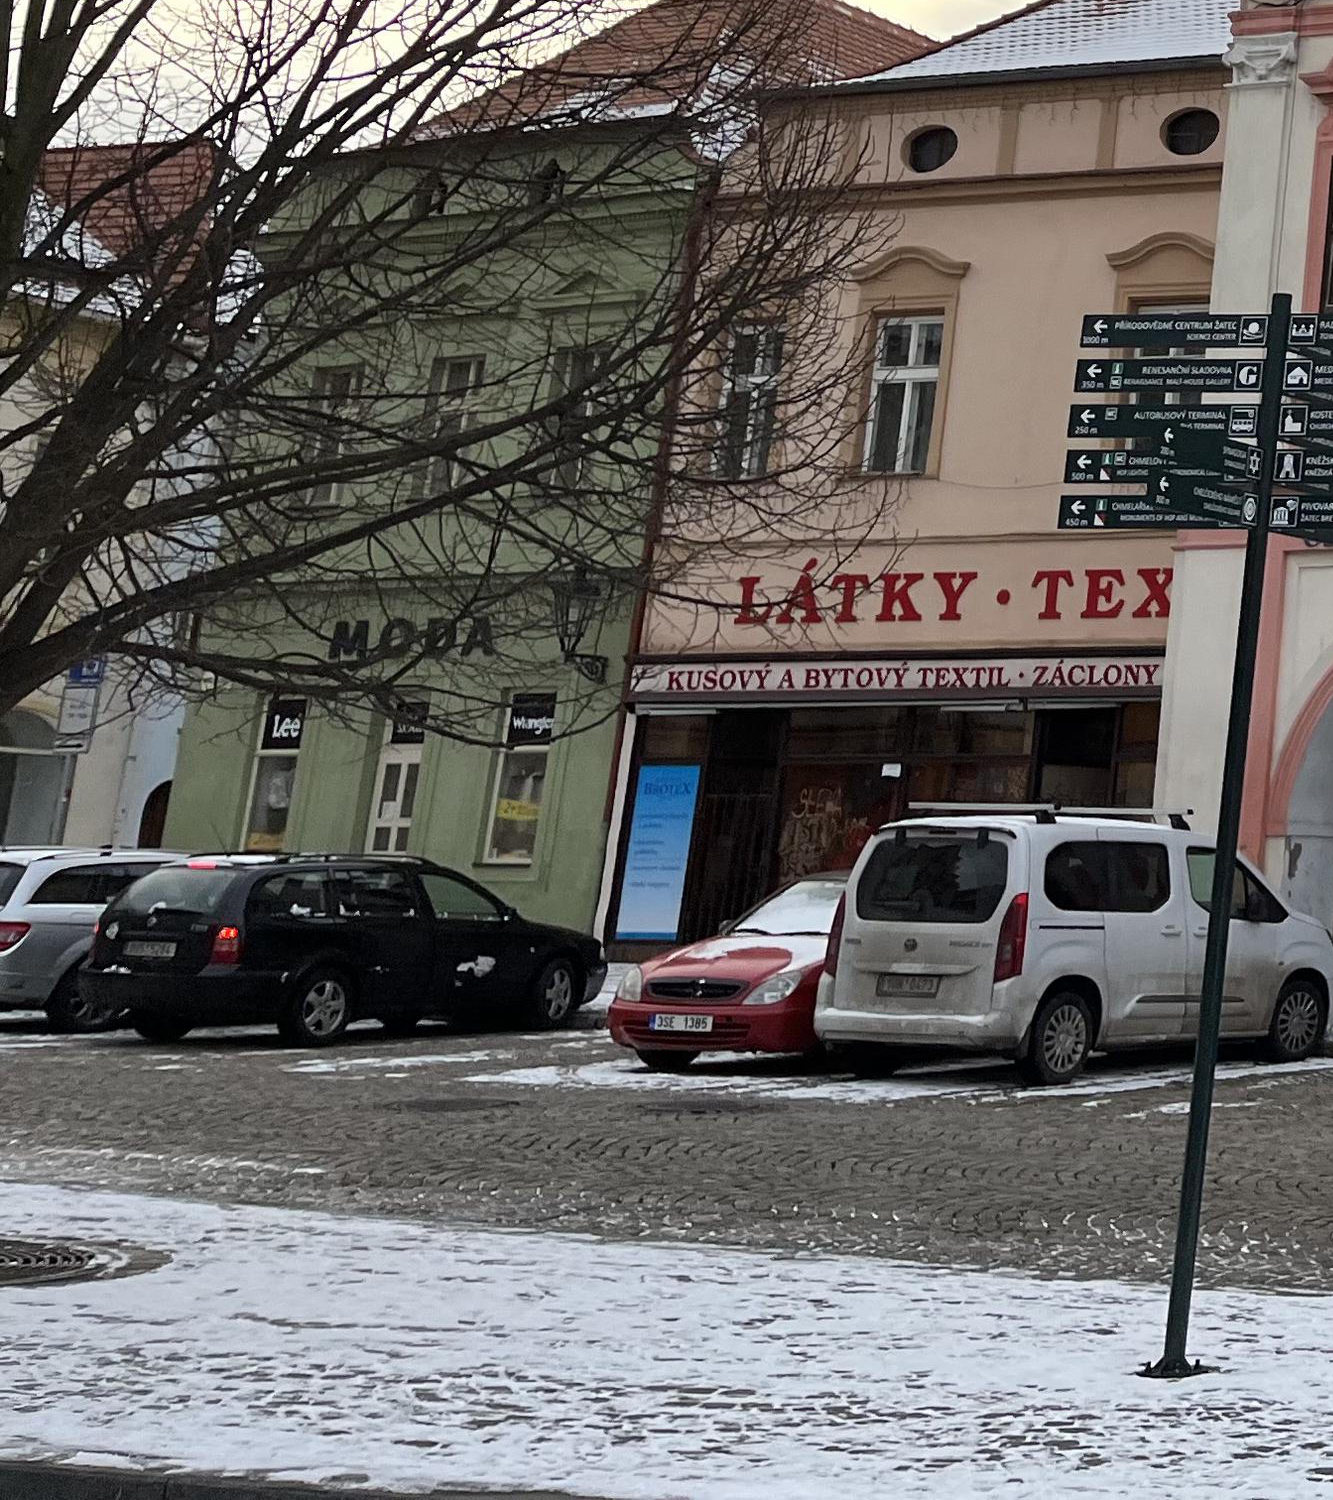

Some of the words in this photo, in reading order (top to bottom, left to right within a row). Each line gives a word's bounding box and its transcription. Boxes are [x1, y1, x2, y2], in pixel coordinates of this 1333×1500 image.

[1175, 320, 1213, 330] CENTRUM
[1214, 319, 1238, 330] ŽATEC
[1186, 333, 1212, 341] SCIENCE
[1212, 333, 1237, 341] CENTER
[1191, 366, 1233, 375] SLADOVNA
[1133, 410, 1187, 420] AUTOBUSOVÝ
[1187, 410, 1228, 420] TERMINÁL
[1075, 426, 1090, 434] 250
[1193, 422, 1225, 430] TERMINAL
[1065, 518, 1080, 526] 450
[1300, 513, 1320, 522] ŽATEC
[733, 557, 978, 625] LÁTKY
[329, 616, 496, 661] MODA
[666, 661, 773, 692] KUSOVÝ
[778, 669, 796, 691] A
[802, 662, 910, 690] BYTOVÝ
[916, 666, 1010, 689] TEXTIL
[1032, 659, 1160, 687] ZÁCLONY
[272, 714, 300, 738] Lee
[513, 715, 554, 735] Wrangle
[657, 1015, 675, 1029] 3SE
